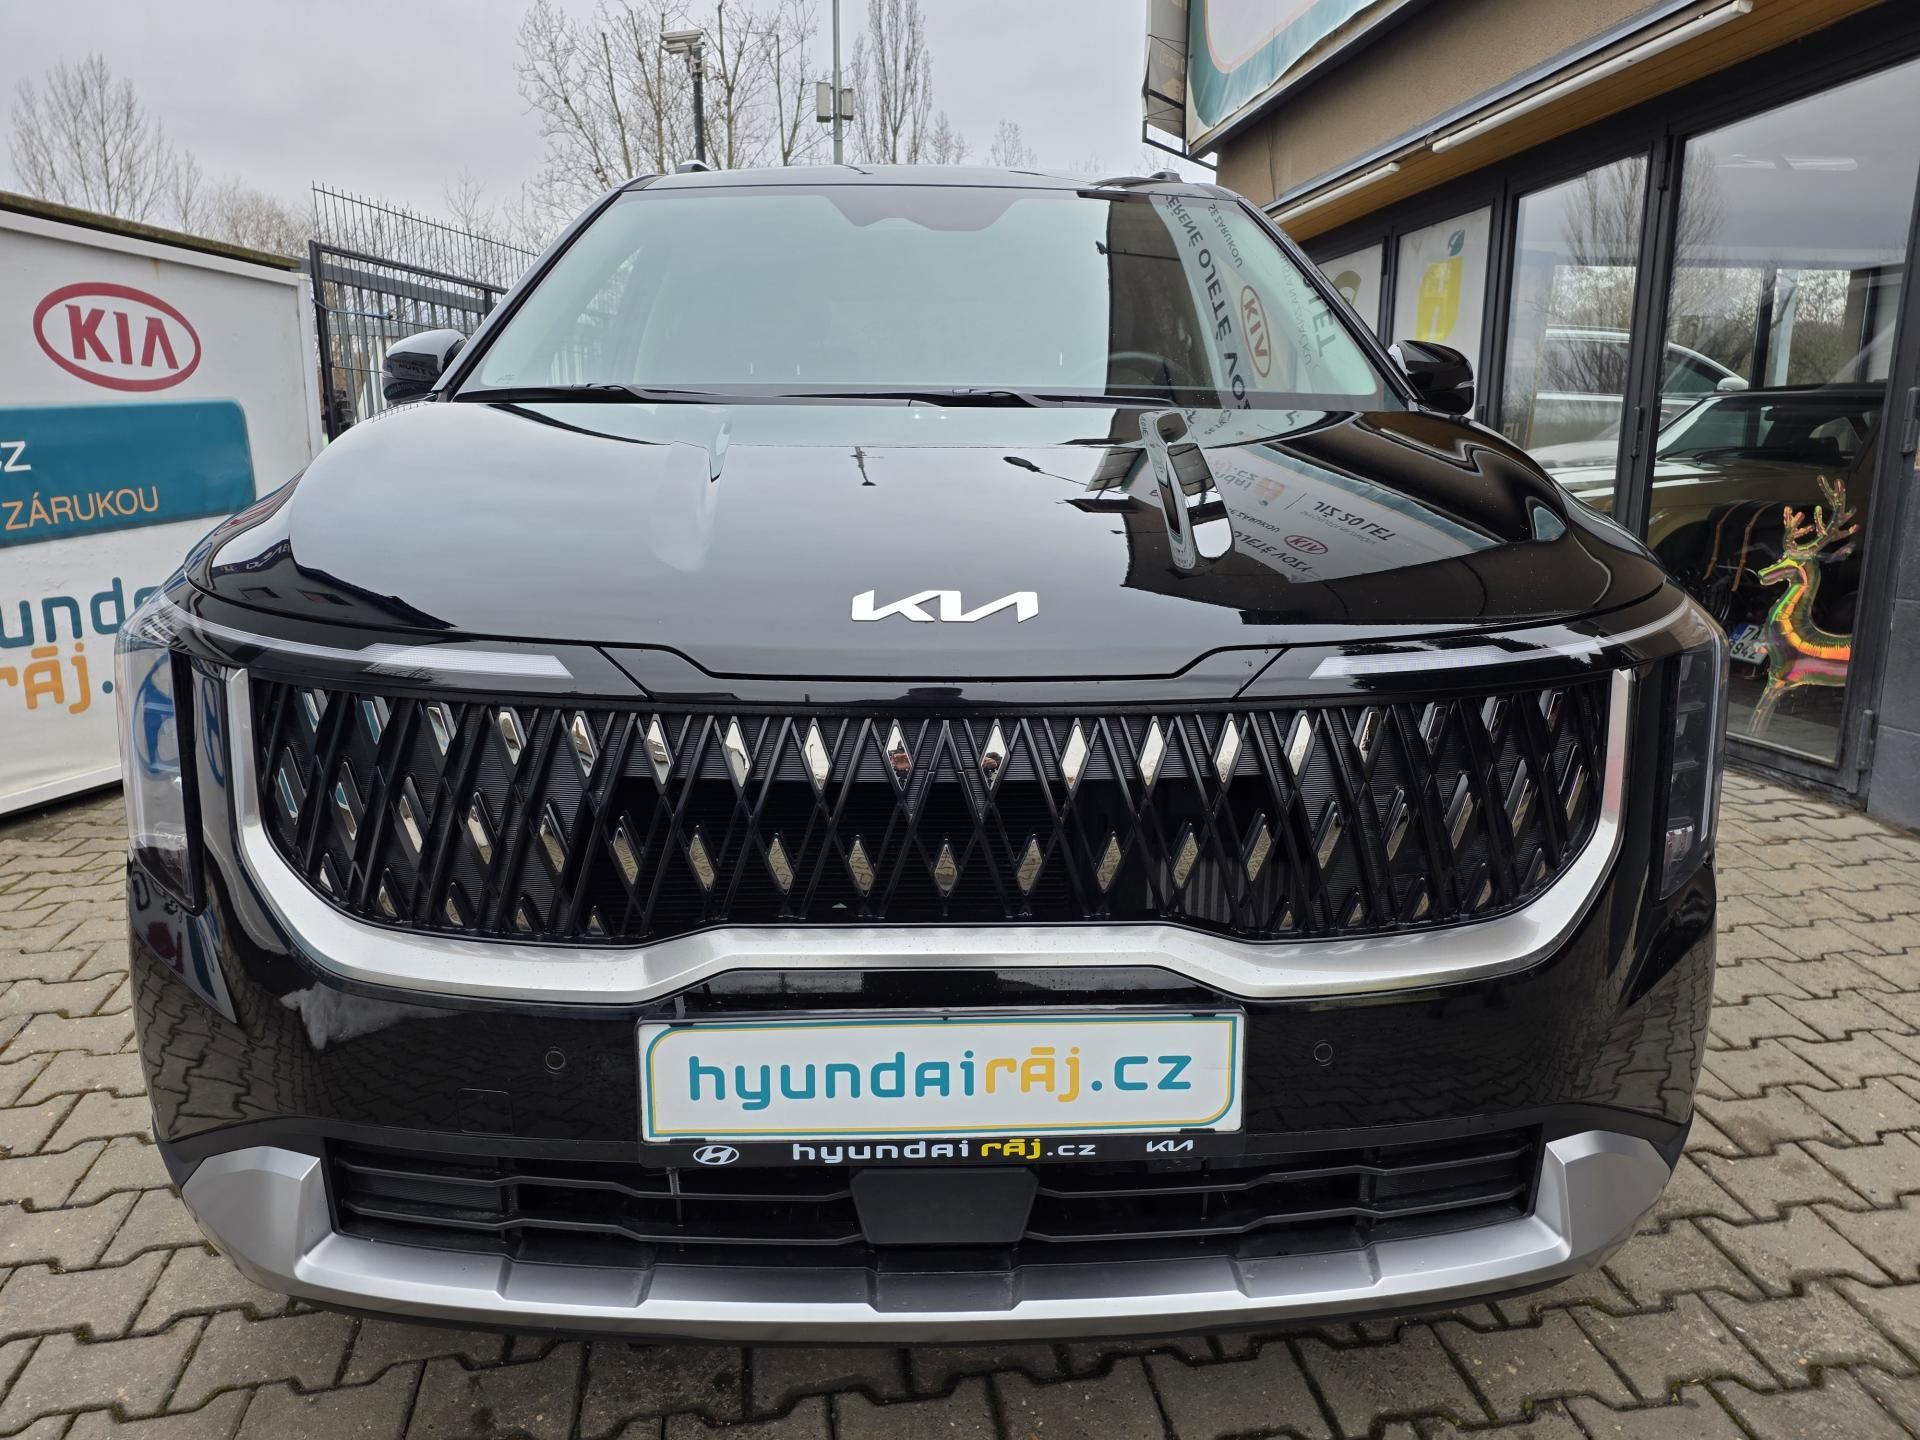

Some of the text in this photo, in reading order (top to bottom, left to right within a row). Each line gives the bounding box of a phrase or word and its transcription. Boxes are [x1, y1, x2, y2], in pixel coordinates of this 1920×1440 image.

[65, 305, 180, 370] KIA
[2, 486, 159, 531] ZÁRUKOU
[851, 589, 1039, 623] KIA
